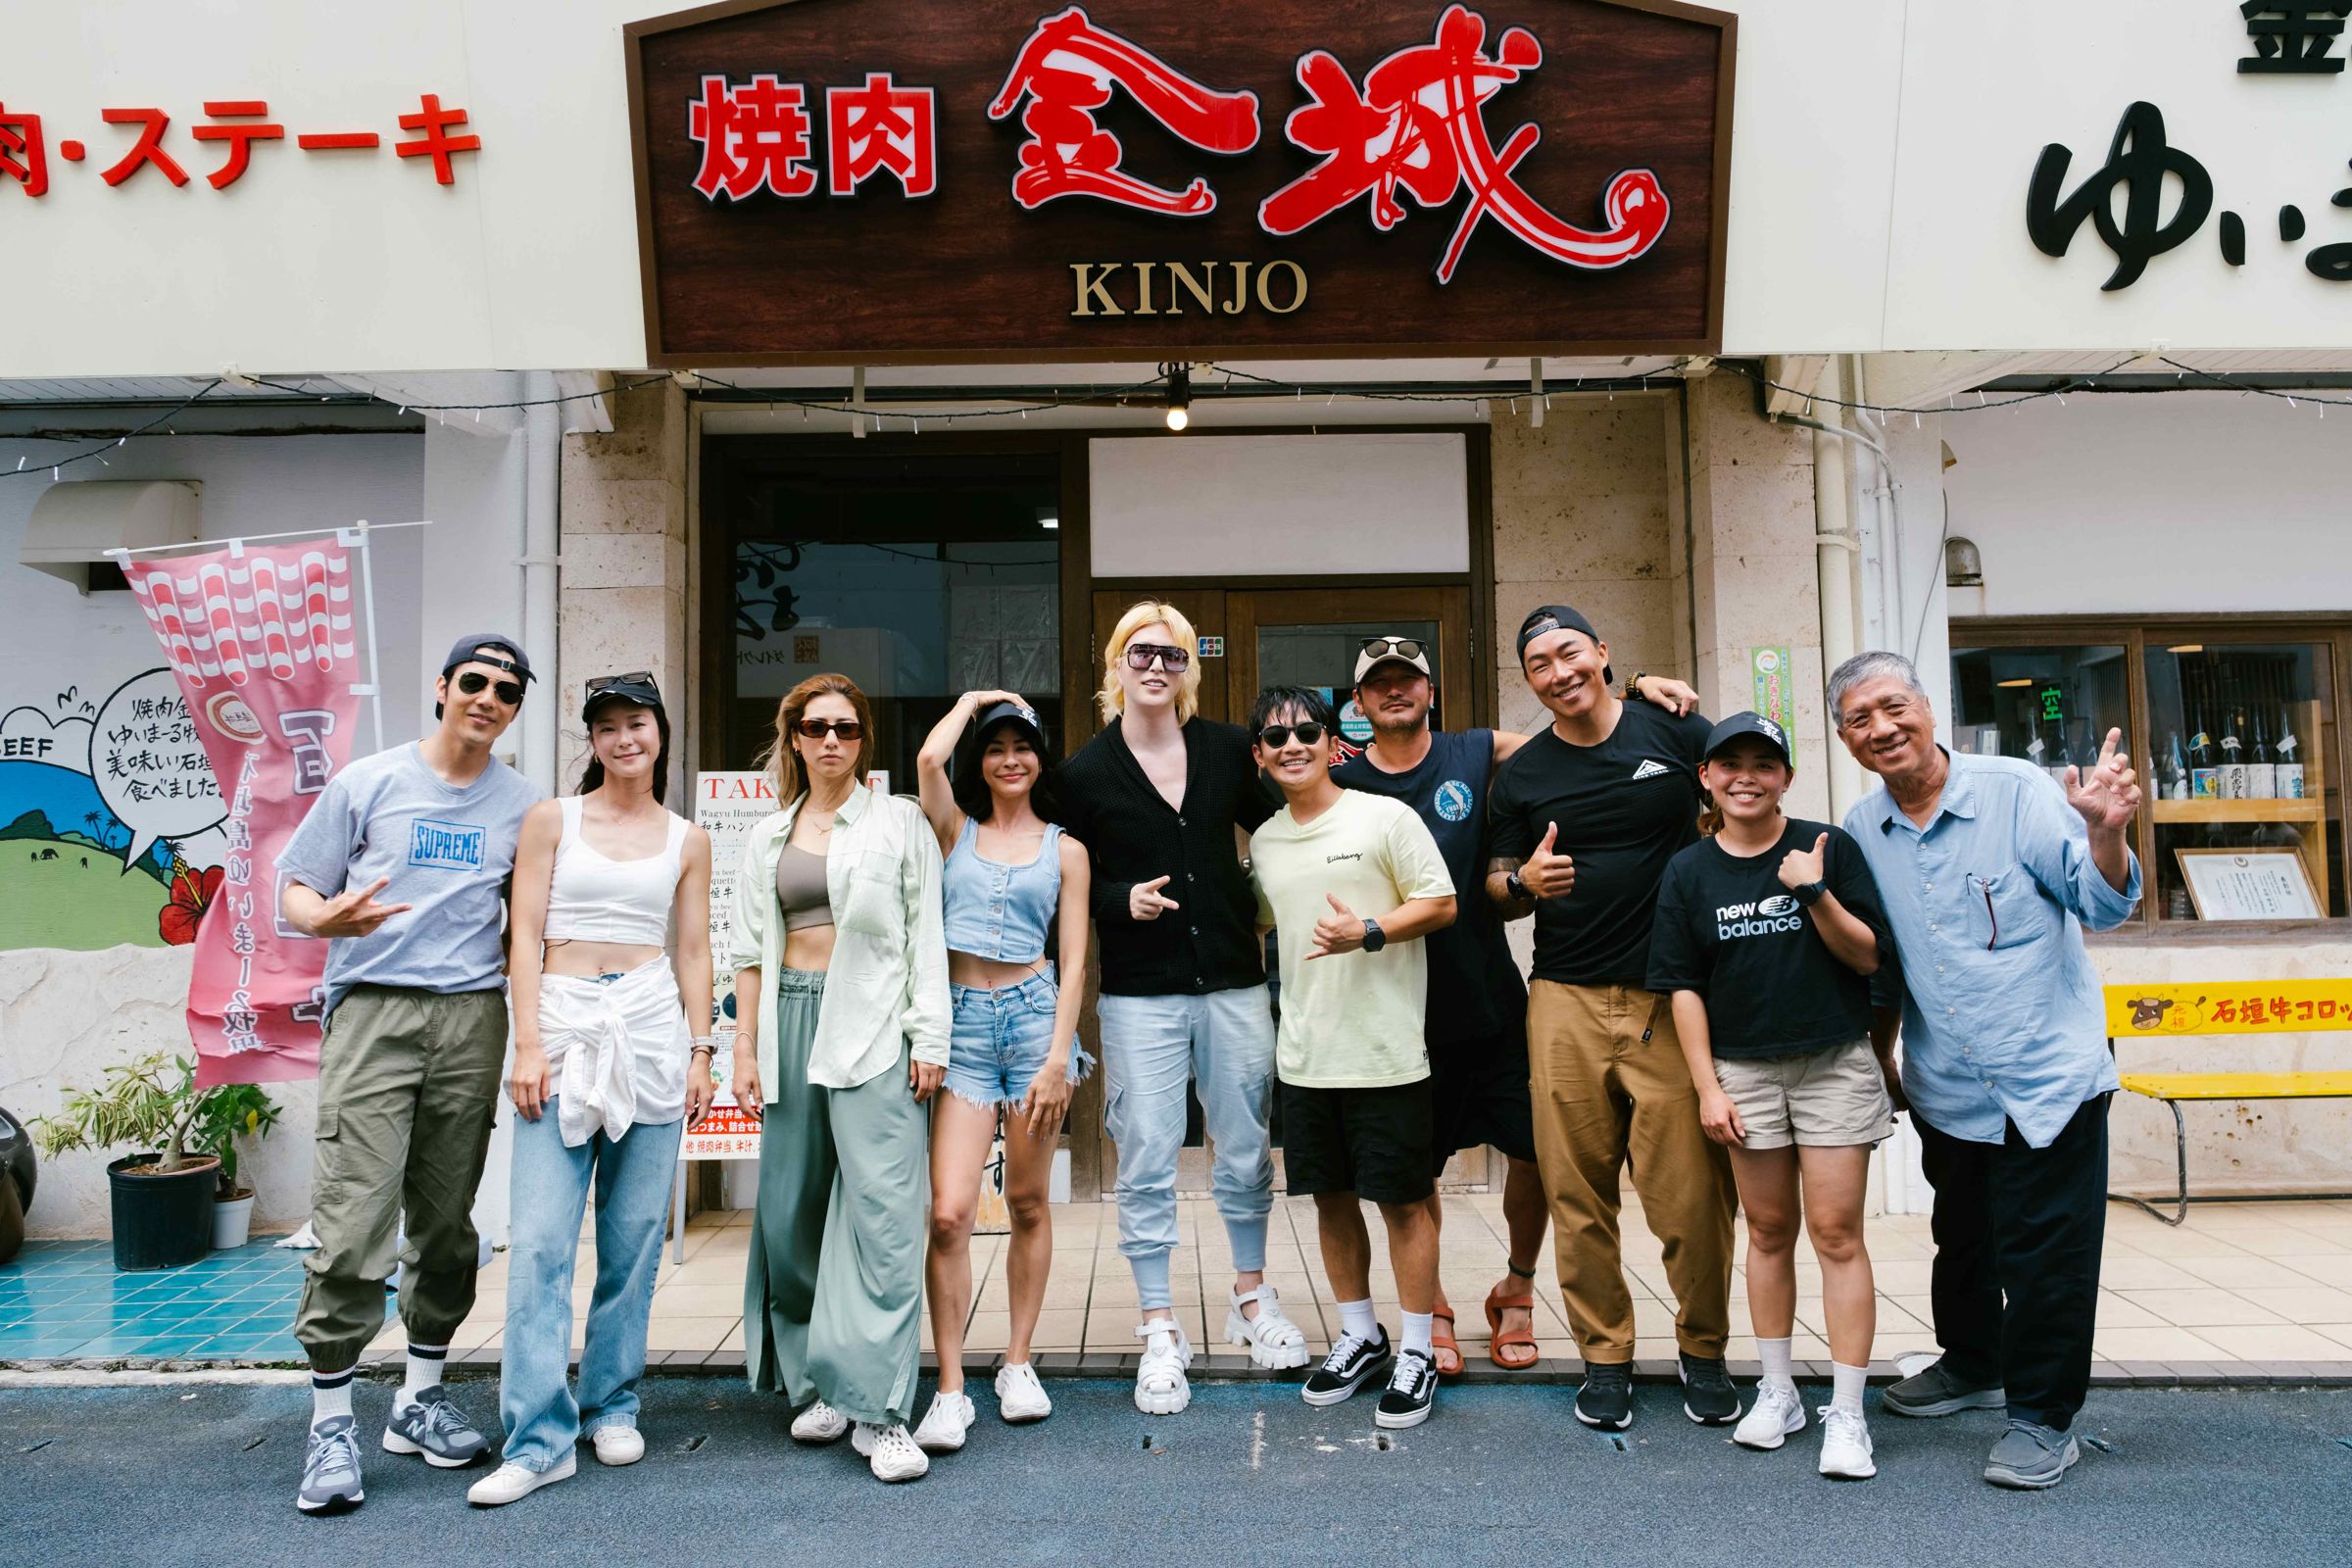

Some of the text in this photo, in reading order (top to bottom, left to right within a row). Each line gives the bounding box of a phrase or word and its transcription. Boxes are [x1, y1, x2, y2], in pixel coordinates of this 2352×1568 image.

[689, 3, 1671, 285] 焼肉 金城
[1069, 260, 1308, 316] KINJO
[2040, 687, 2063, 721] 空
[0, 737, 54, 759] EEF
[704, 777, 776, 800] TAK
[415, 825, 481, 865] SUPREME
[1716, 902, 1757, 922] new
[1718, 915, 1803, 941] balance
